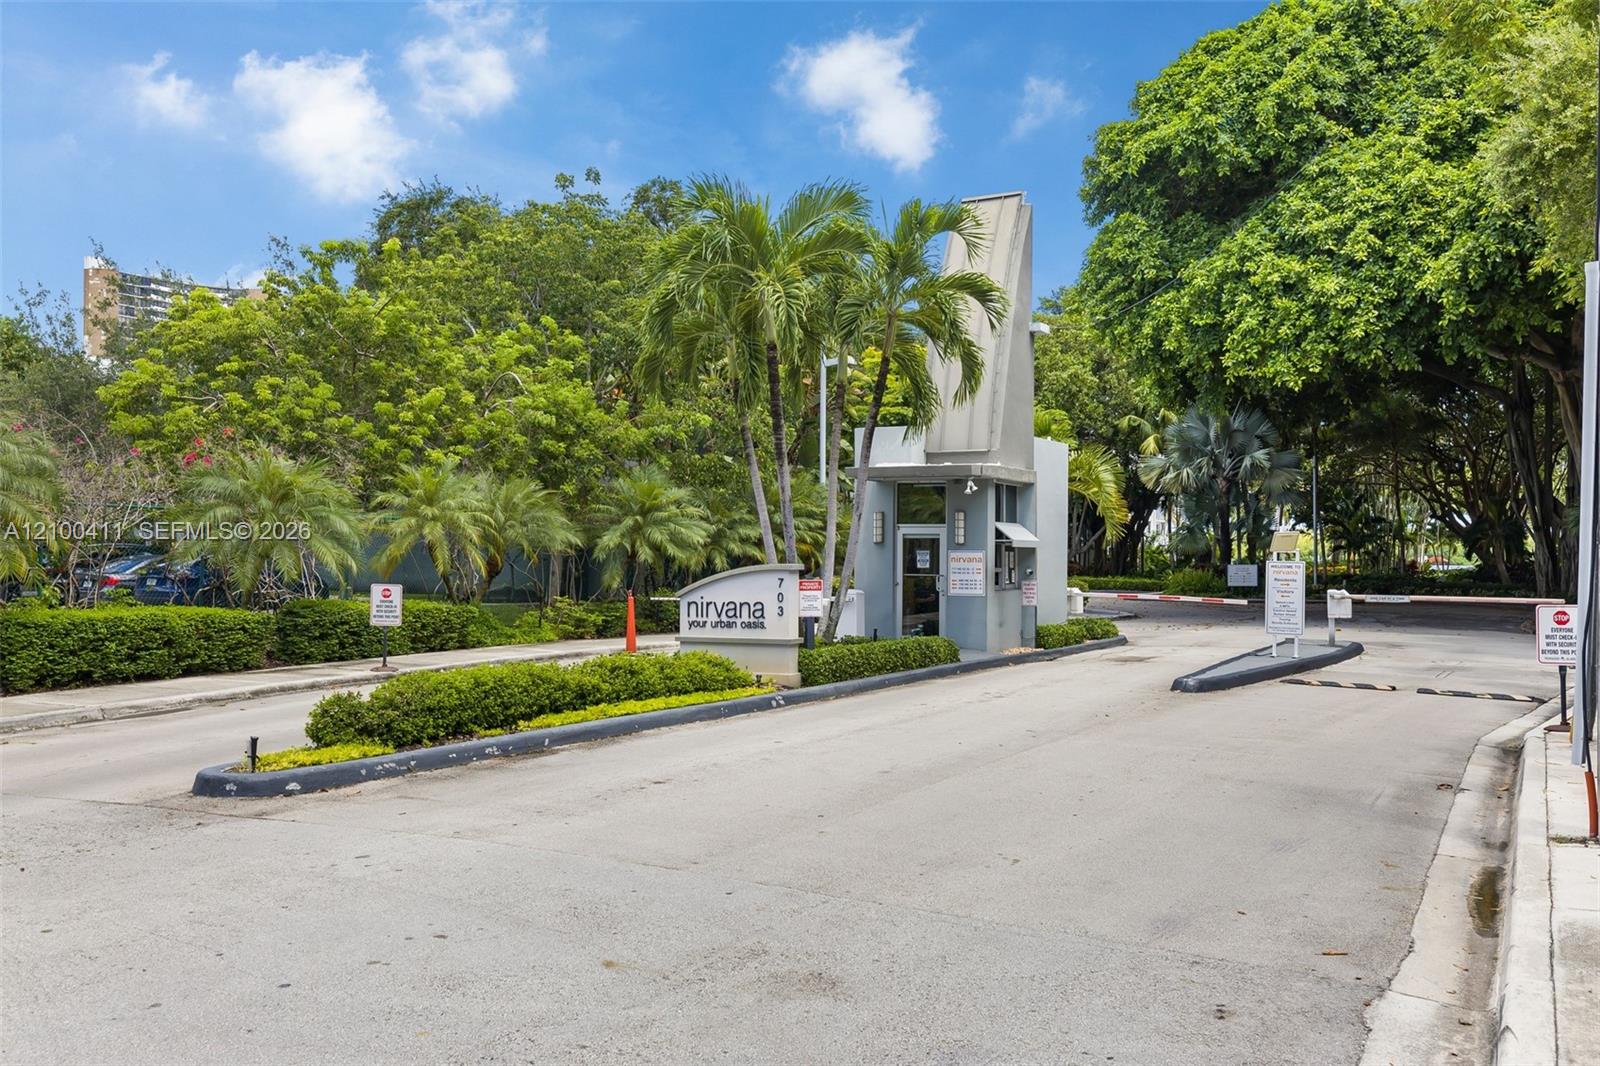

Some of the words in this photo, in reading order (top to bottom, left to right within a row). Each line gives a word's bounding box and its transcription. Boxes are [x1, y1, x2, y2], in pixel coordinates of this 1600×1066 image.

[687, 596, 766, 619] nirvana
[1554, 614, 1569, 622] STOP
[688, 620, 707, 630] your
[711, 619, 737, 629] urban
[741, 620, 767, 629] oasis.
